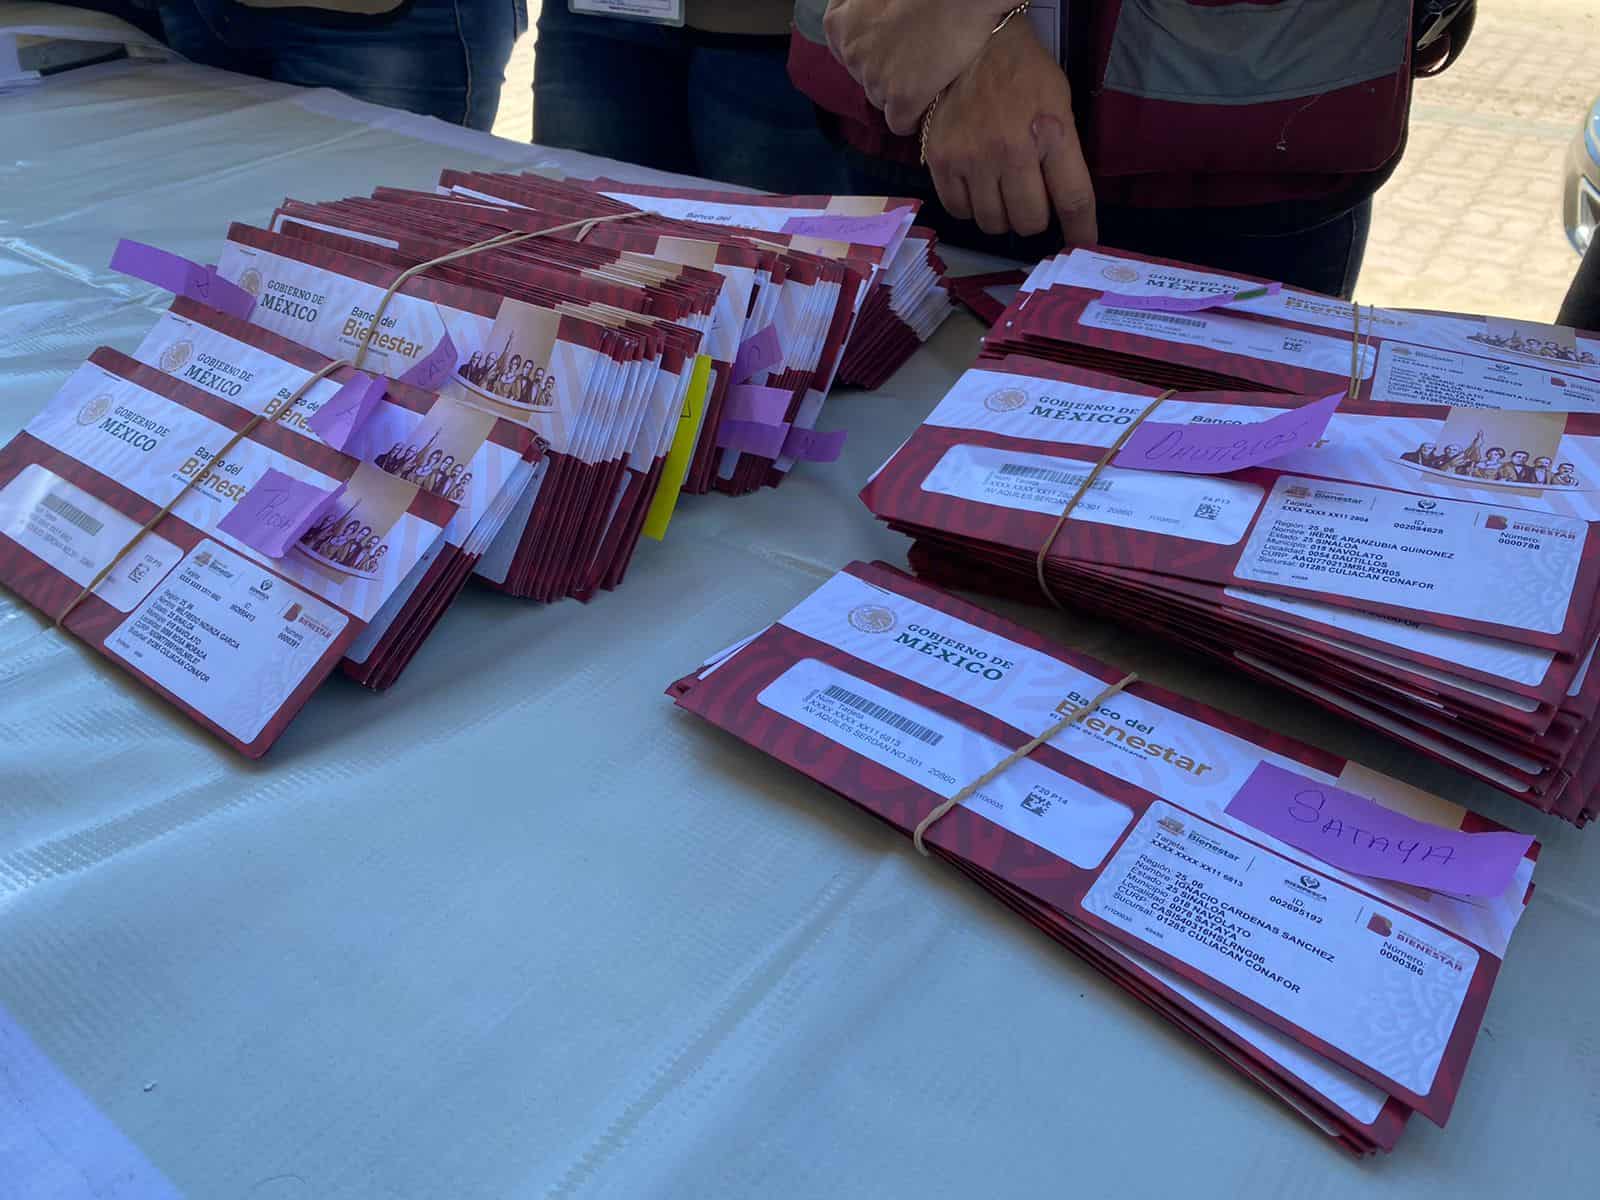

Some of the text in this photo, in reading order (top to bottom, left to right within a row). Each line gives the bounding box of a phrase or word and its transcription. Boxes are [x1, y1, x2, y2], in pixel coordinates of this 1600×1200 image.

[266, 279, 325, 305] GOBIERNO DE
[260, 292, 319, 323] MÉXICO
[380, 316, 396, 329] del
[341, 317, 424, 359] Bienestar
[195, 351, 253, 382] GOBIERNO DE
[183, 363, 242, 401] MÉXICO
[277, 386, 307, 408] Baco
[1028, 403, 1134, 426] MÉXICO
[1036, 396, 1141, 415] GOBIERNO DE
[98, 415, 159, 454] MÉXICO
[113, 405, 170, 437] GOBIERNO DE
[1191, 415, 1243, 428] Banco
[193, 446, 243, 476] Bano del
[176, 456, 251, 504] Bienest
[1309, 530, 1337, 540] IRENE
[1314, 537, 1359, 550] SINALOA
[1328, 546, 1383, 560] NAVOLATO
[1331, 553, 1388, 568] DAUTILLOS
[1327, 566, 1379, 581] CULIACAN
[1381, 575, 1434, 590] CONAFOR
[892, 630, 1006, 684] MÉXICO
[905, 622, 1015, 670] GOBIERNO DE
[1122, 716, 1155, 735] del
[1288, 789, 1457, 866] SATAYA
[1187, 832, 1241, 862] Bienestar
[1174, 871, 1187, 881] 25
[1190, 879, 1204, 889] 06
[1166, 883, 1179, 894] 25
[1179, 889, 1226, 918] SINALOA
[1168, 901, 1193, 918] 0078
[1194, 913, 1238, 941] SATAYA
[1172, 895, 1191, 908] 018
[1191, 904, 1251, 939] NAVOLATO
[1174, 878, 1219, 905] IGNACIO
[1219, 900, 1280, 935] CARDENAS
[1281, 931, 1335, 963] SANCHEZ
[1155, 913, 1186, 933] 01285
[1187, 928, 1243, 963] CULIACAN
[1243, 958, 1301, 993] CONAFOR
[1378, 947, 1425, 976] 0000386
[1394, 933, 1464, 972] BIENESTAR
